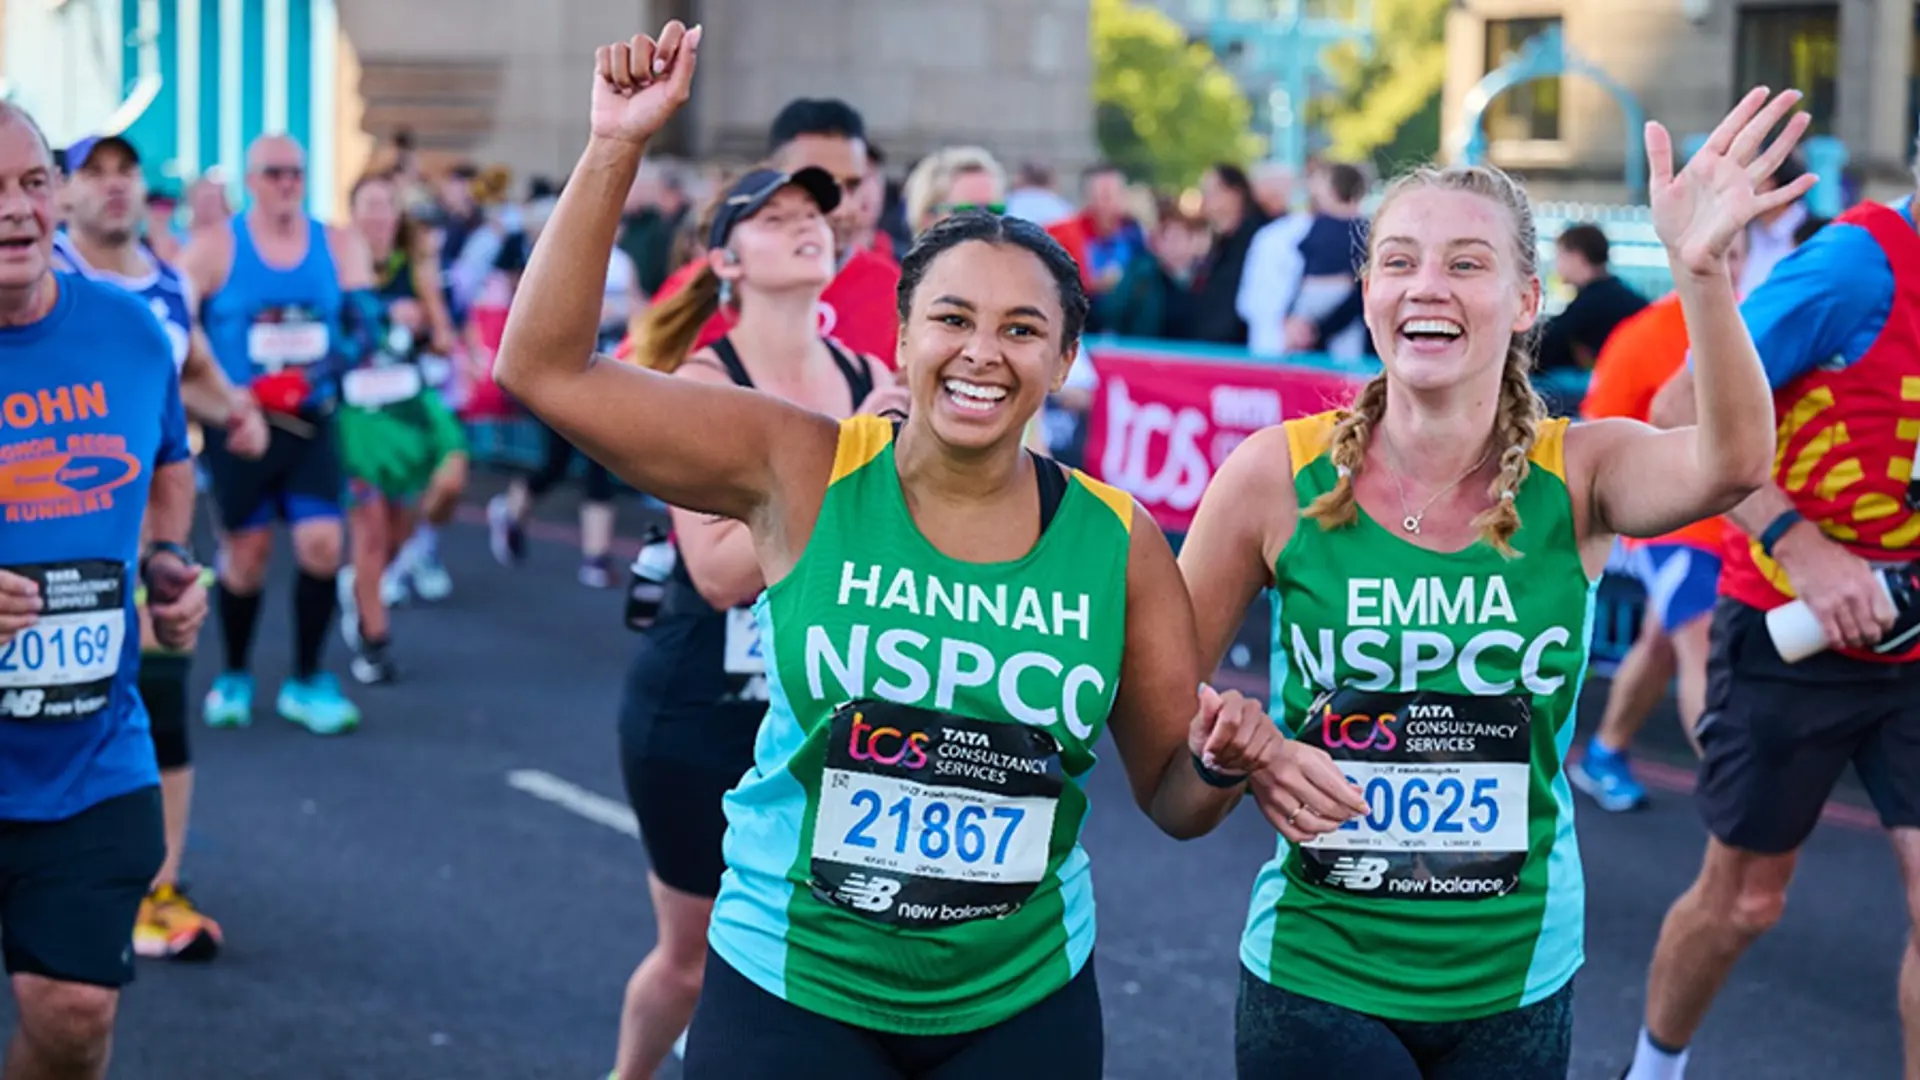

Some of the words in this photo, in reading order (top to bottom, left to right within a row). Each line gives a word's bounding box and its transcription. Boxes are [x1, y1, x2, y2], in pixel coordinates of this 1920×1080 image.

[0, 382, 109, 430] OHN
[1102, 375, 1208, 510] tcs
[6, 491, 114, 522] RUNNERS
[837, 561, 1090, 640] HANNAH
[1347, 575, 1517, 626] EMMA
[805, 624, 1105, 739] NSPCC
[1291, 622, 1570, 696] NSPCC
[1323, 703, 1397, 751] tcs
[1406, 721, 1518, 738] CONSULTANCY
[1408, 705, 1455, 718] TATA
[848, 711, 930, 769] tcs
[937, 744, 1048, 775] CONSULTANCY
[941, 728, 990, 747] TATA
[1406, 737, 1475, 752] SERVICES
[934, 760, 1007, 784] SERVICES
[843, 789, 1025, 865] 21867
[1338, 776, 1499, 833] 0625
[837, 873, 902, 913] NB
[898, 903, 937, 919] new
[1324, 857, 1389, 890] NB
[1389, 878, 1429, 892] new
[1431, 875, 1504, 893] balance
